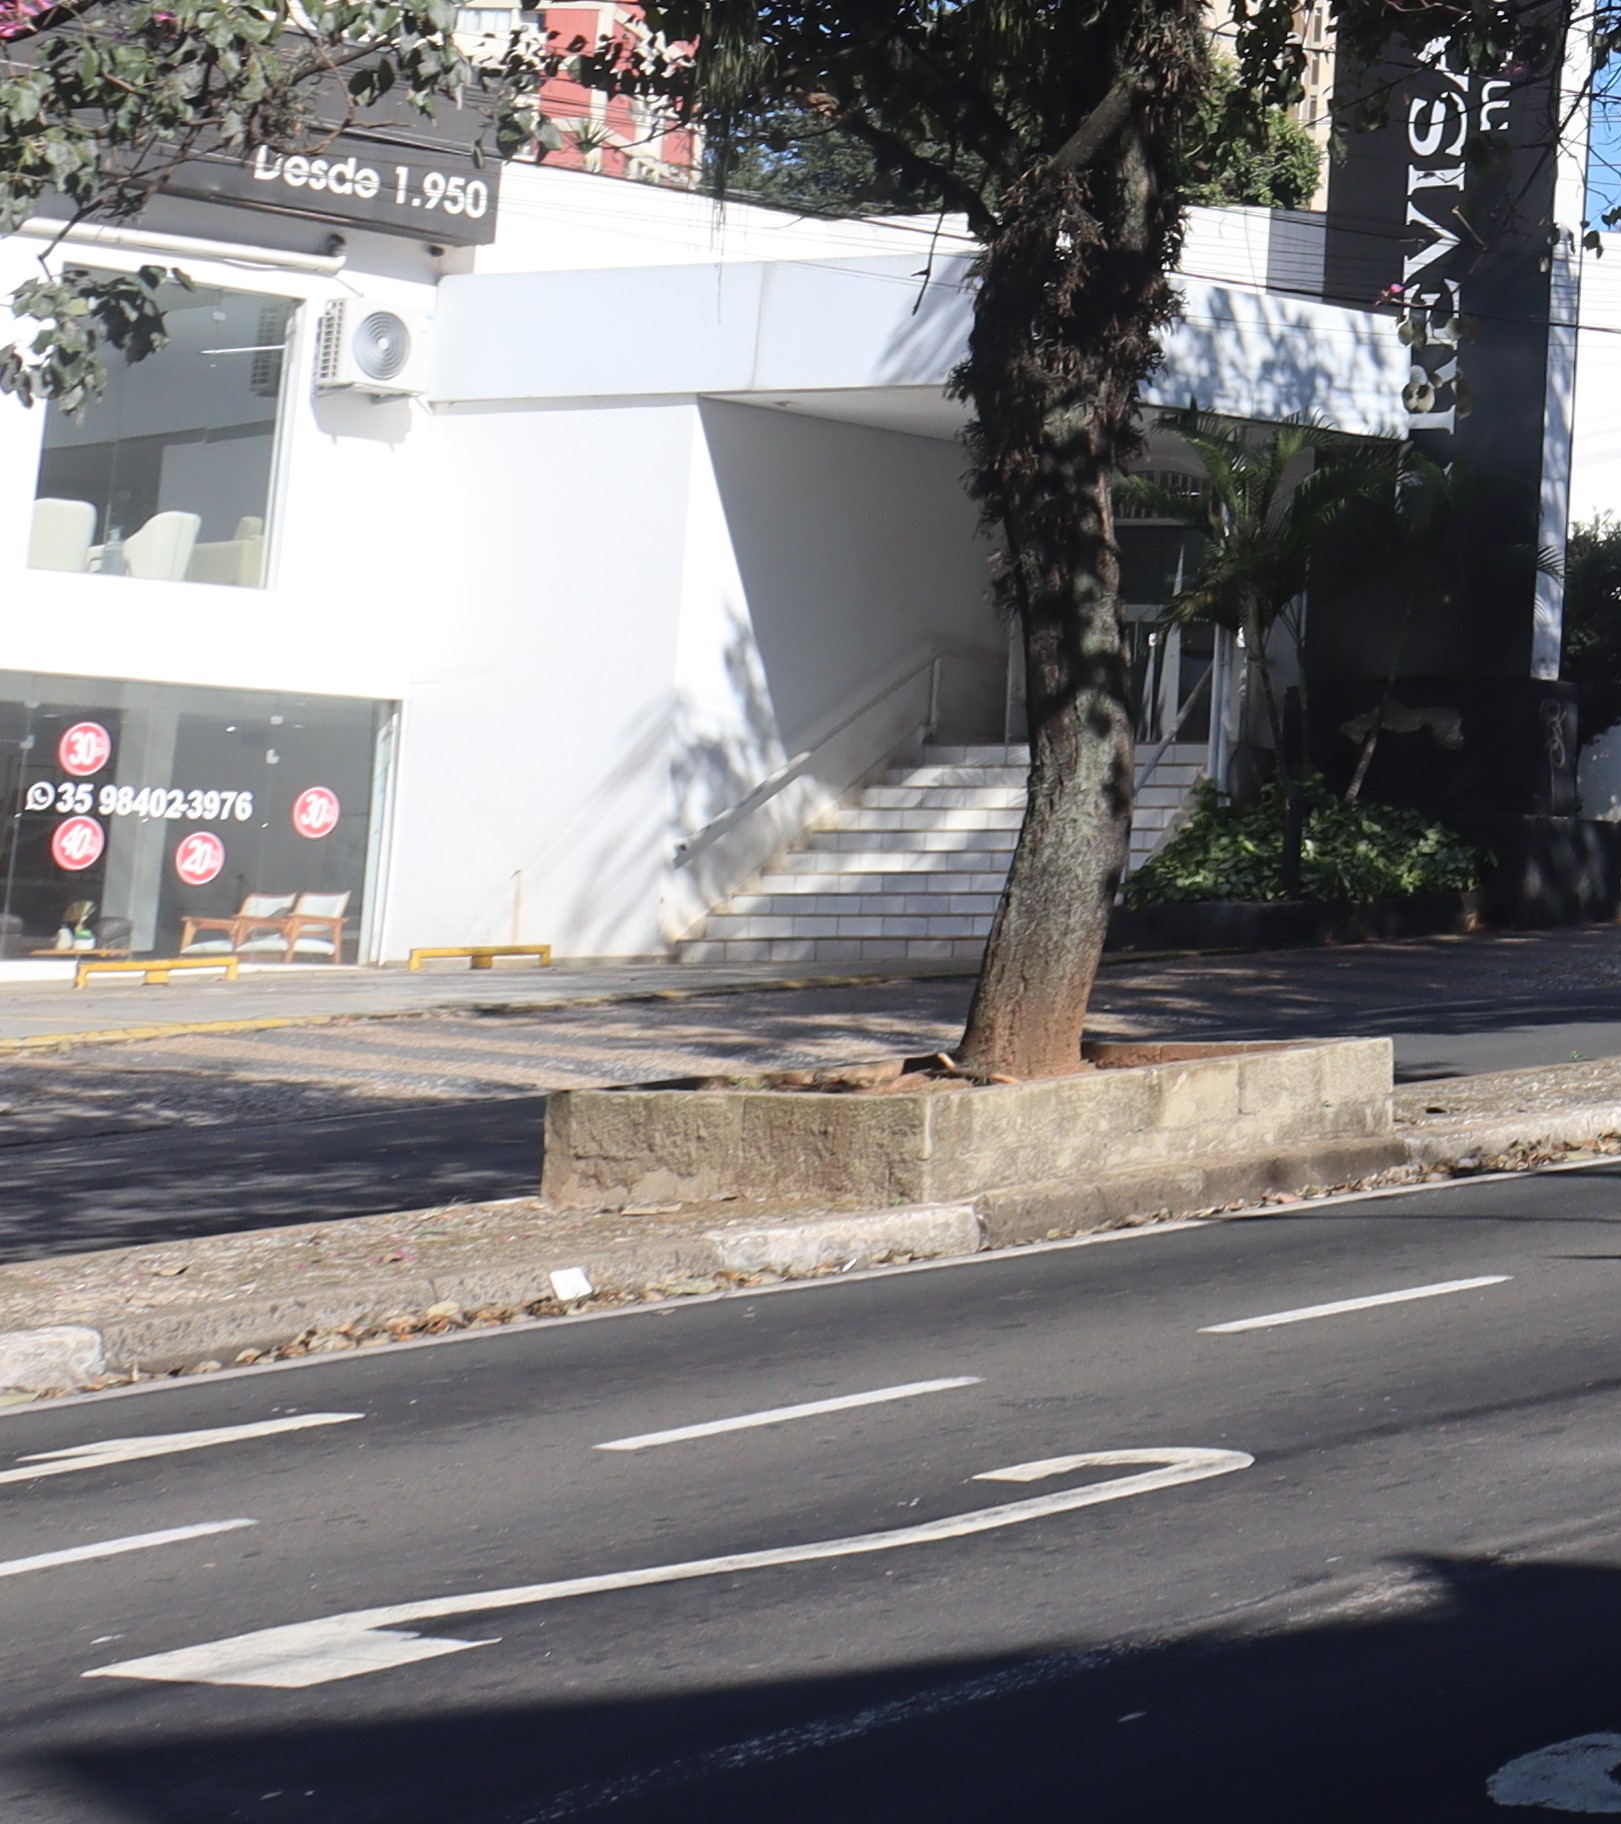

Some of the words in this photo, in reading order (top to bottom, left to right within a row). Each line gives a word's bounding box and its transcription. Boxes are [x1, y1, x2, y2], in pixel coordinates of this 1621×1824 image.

[254, 144, 380, 199] Desde
[395, 166, 489, 219] 1.950
[68, 731, 97, 766] 30
[56, 782, 94, 813] 35
[99, 785, 254, 821] 98402-3976
[302, 793, 329, 827] 30
[60, 827, 89, 857] 40
[181, 843, 211, 874] 20
